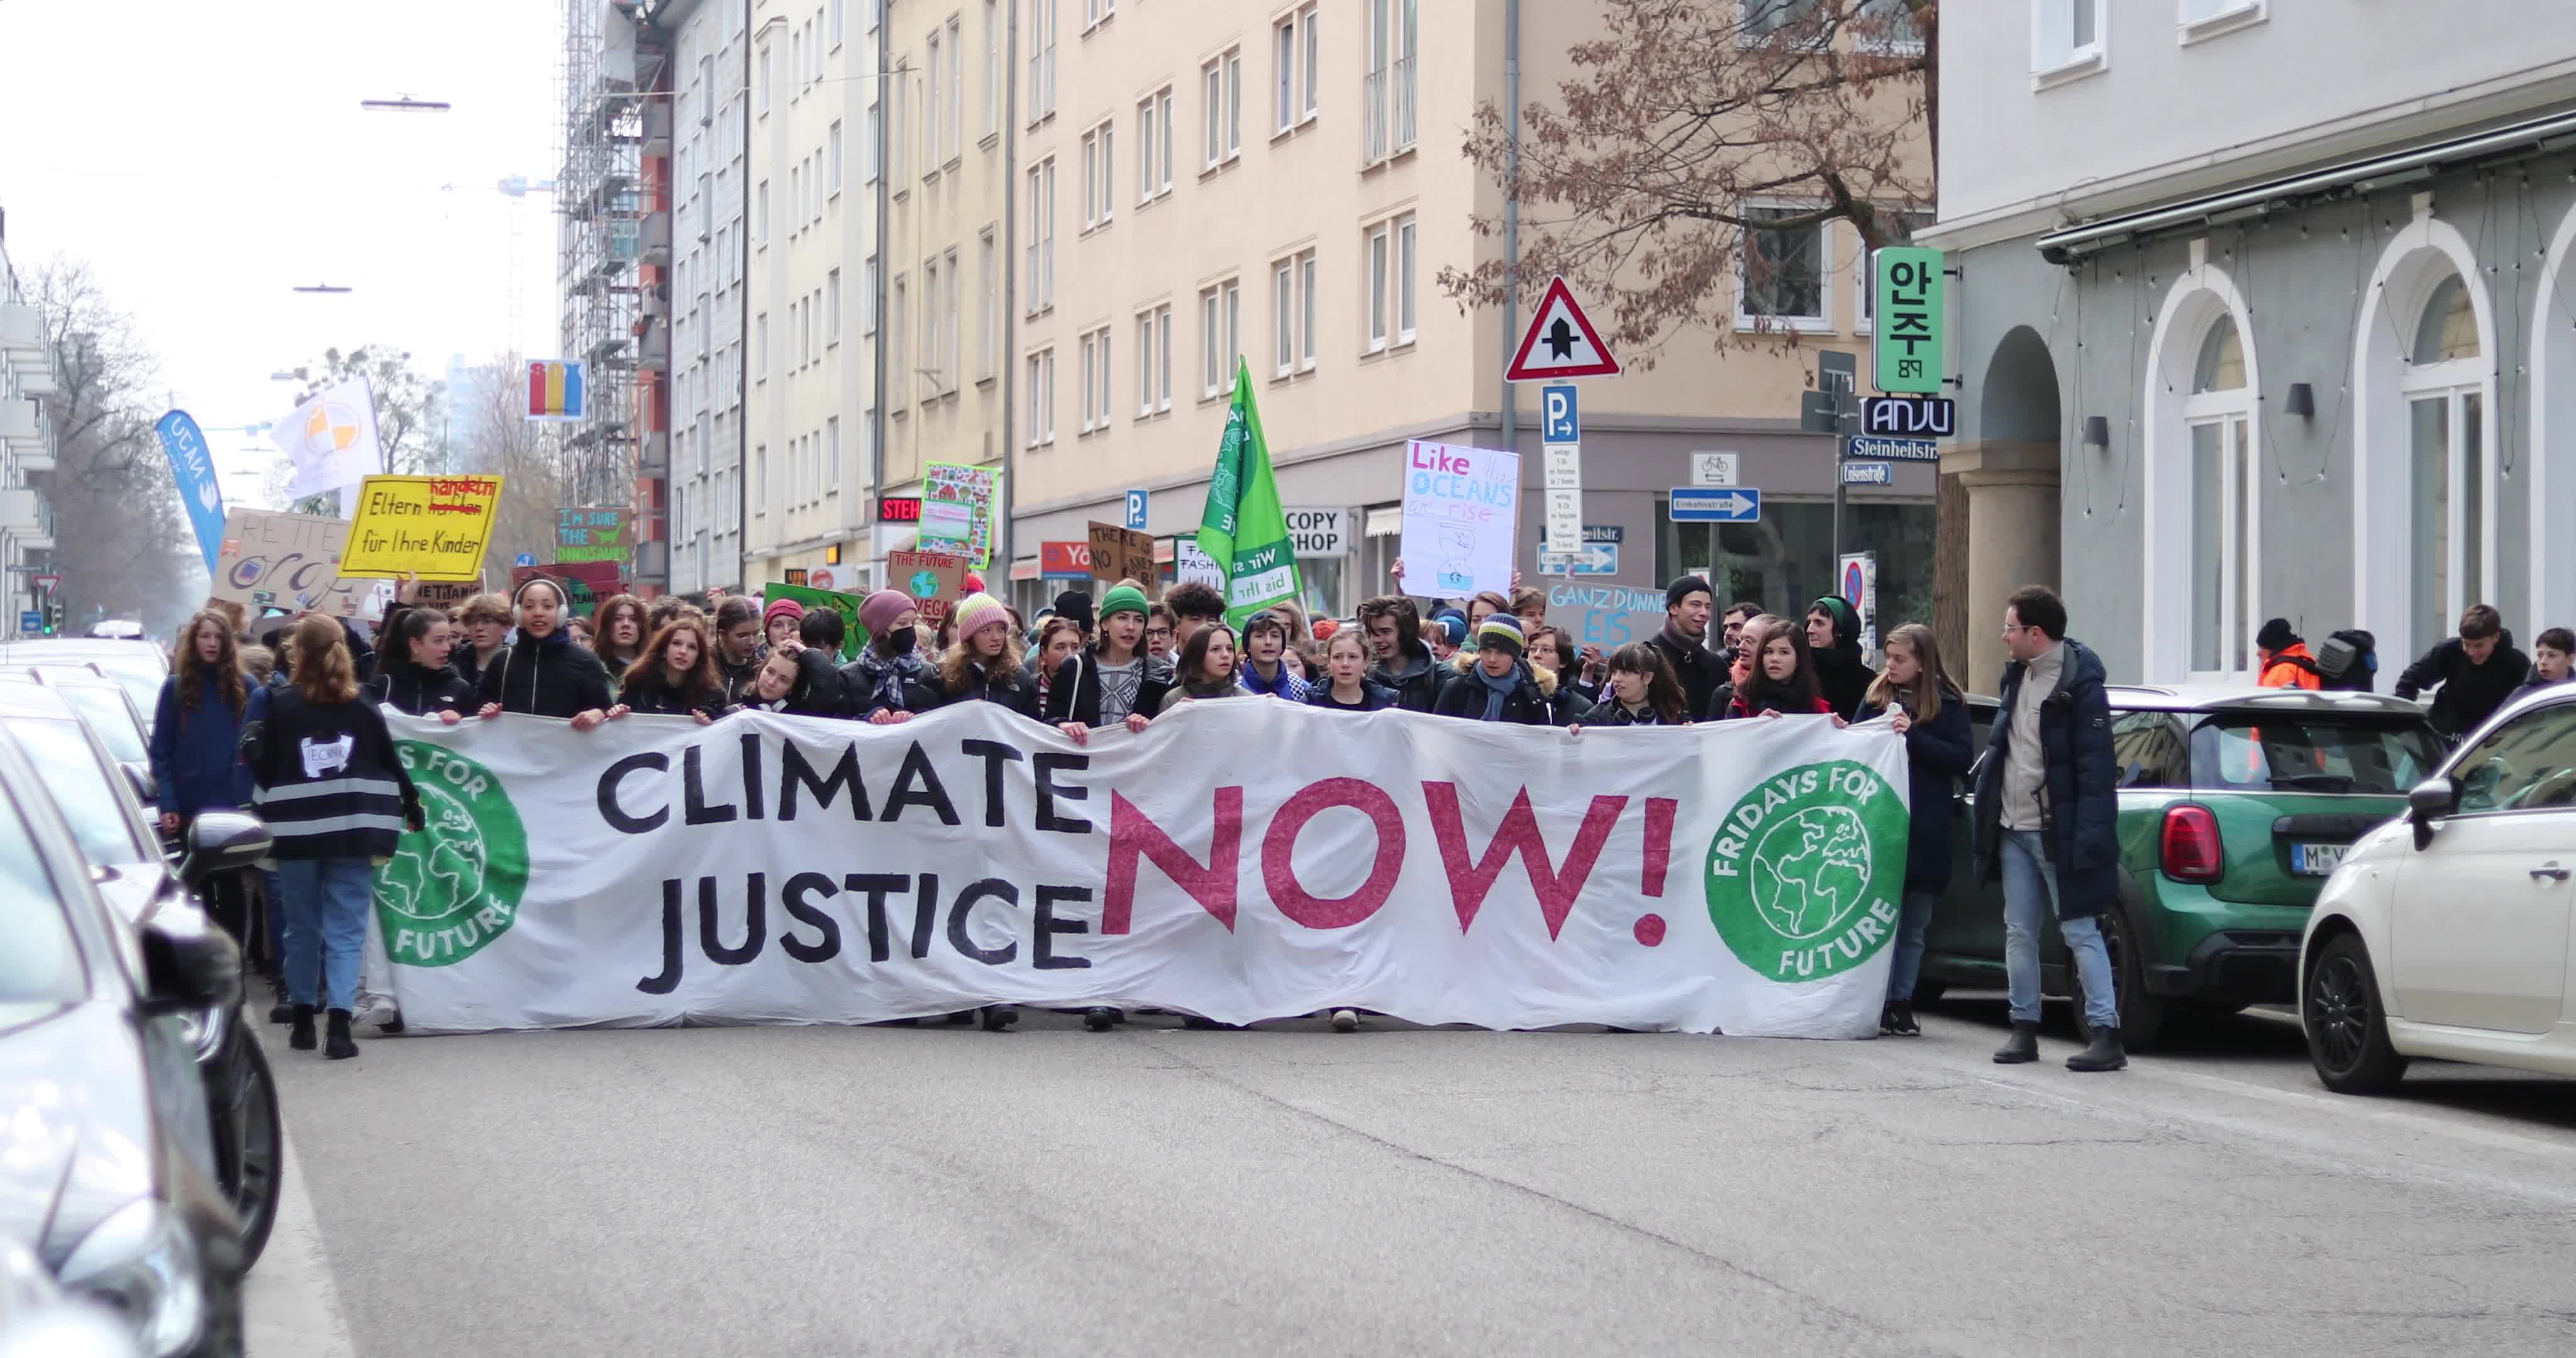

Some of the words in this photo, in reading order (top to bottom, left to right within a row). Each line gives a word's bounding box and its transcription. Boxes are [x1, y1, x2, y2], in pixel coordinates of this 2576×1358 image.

[1890, 262, 1932, 355] 안주
[1548, 393, 1567, 436] P
[1873, 400, 1948, 432] ANJU
[1413, 442, 1470, 476] Like
[1855, 439, 1938, 460] Steinheilstr.
[1413, 472, 1513, 507] OCEANS
[369, 492, 422, 516] Eltern
[1129, 494, 1142, 524] P
[1448, 503, 1491, 522] rise
[587, 512, 619, 526] SURE
[1286, 512, 1338, 531] COPY
[362, 529, 387, 553] für
[431, 531, 480, 554] Kinder
[559, 528, 589, 545] THE
[1091, 527, 1137, 548] THERE
[557, 545, 628, 562] DINOSAURS
[896, 555, 914, 566] THE
[919, 556, 954, 569] FUTURE
[1089, 549, 1111, 571] NO
[914, 599, 952, 616] VEGA
[1550, 583, 1611, 609] GANZ
[1584, 610, 1631, 646] EIS
[426, 749, 489, 802] FOR
[597, 733, 1092, 834] CLIMATE
[1713, 770, 1818, 877] FRIDAYS
[1829, 767, 1879, 805] FOR
[1101, 776, 1678, 947] NOW!
[2306, 847, 2319, 868] M
[394, 893, 511, 959] FUTURE
[635, 871, 1092, 995] JUSTICE
[1778, 897, 1897, 976] FUTURE
